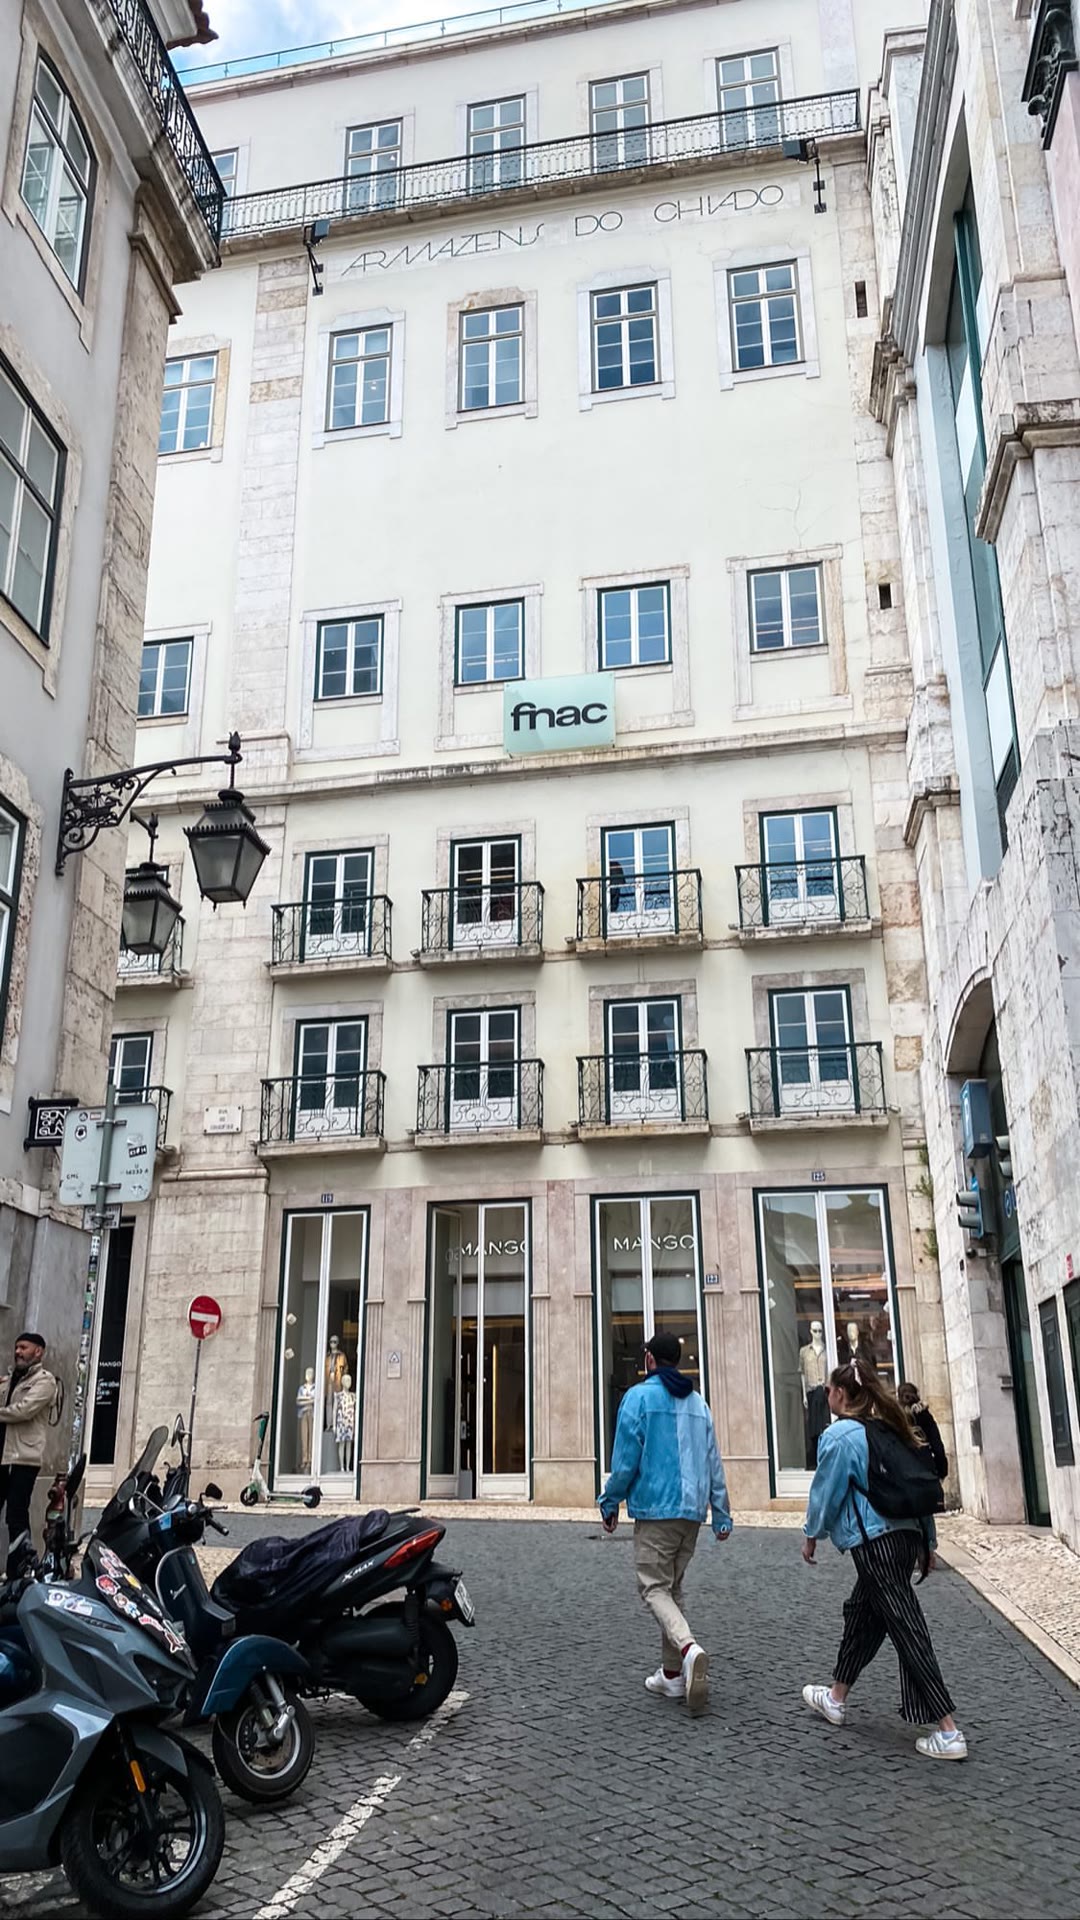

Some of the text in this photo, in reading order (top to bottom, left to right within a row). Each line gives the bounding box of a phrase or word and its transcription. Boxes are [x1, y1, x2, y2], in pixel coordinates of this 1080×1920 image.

[341, 184, 784, 276] ARMAZENS DO CHIADO
[511, 702, 608, 731] fnac
[40, 1110, 67, 1120] SON
[39, 1126, 64, 1136] GUN
[613, 1234, 695, 1251] MANGO
